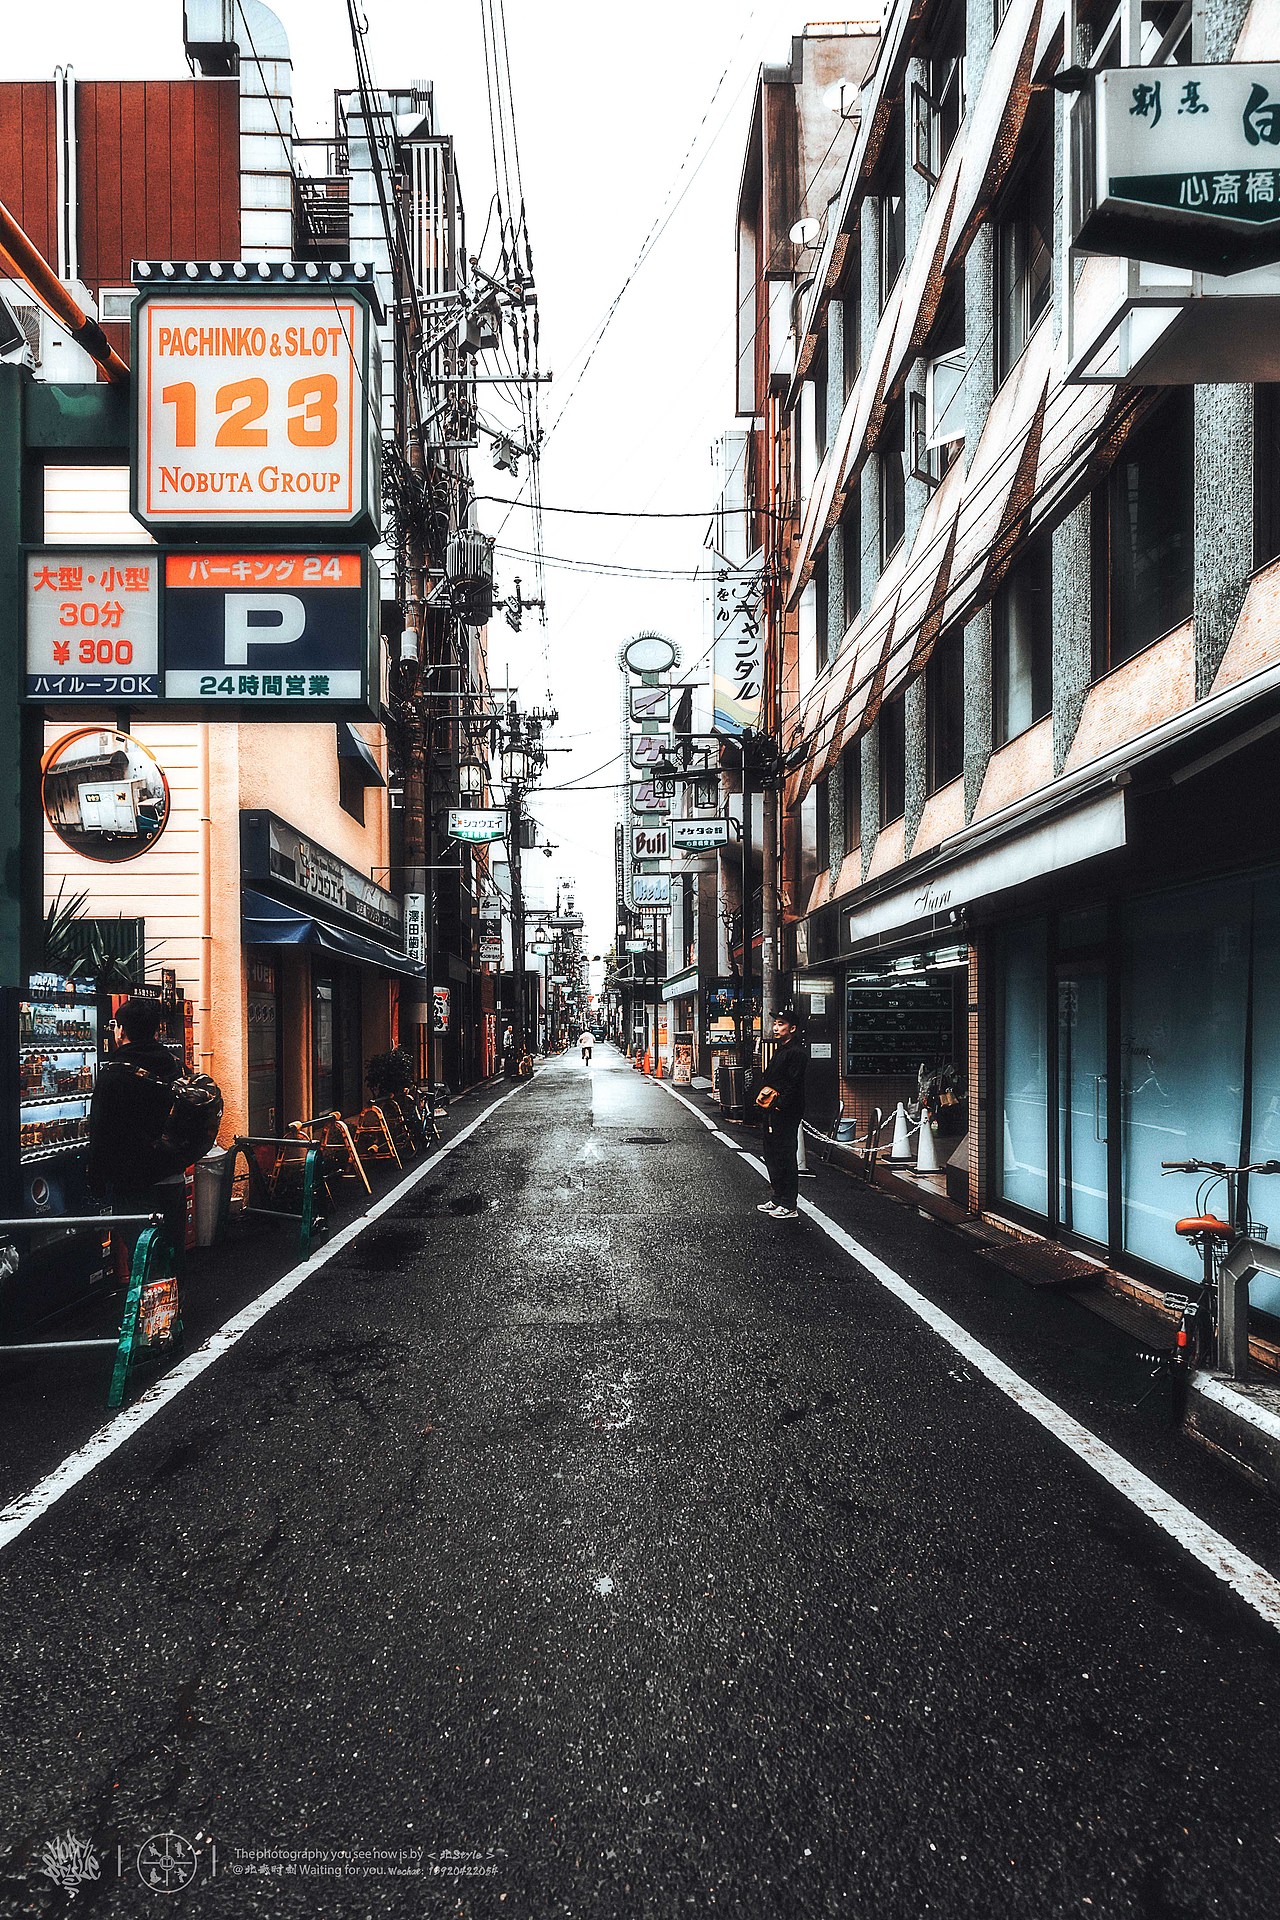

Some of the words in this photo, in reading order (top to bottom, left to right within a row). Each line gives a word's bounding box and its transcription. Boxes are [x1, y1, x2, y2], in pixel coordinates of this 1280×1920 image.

[1179, 171, 1280, 206] 心斎橋
[158, 326, 266, 357] PACHINKO
[284, 326, 343, 357] SLOT
[161, 373, 338, 448] 123
[33, 565, 150, 593] 大型・小型
[187, 557, 297, 583] パーキング
[302, 556, 343, 581] 24
[58, 600, 126, 629] 30分
[224, 592, 307, 666] P
[78, 638, 134, 666] 300
[732, 581, 762, 701] スキャンダル
[34, 676, 153, 694] ハイルーフOK
[199, 674, 331, 697] 24時間営業
